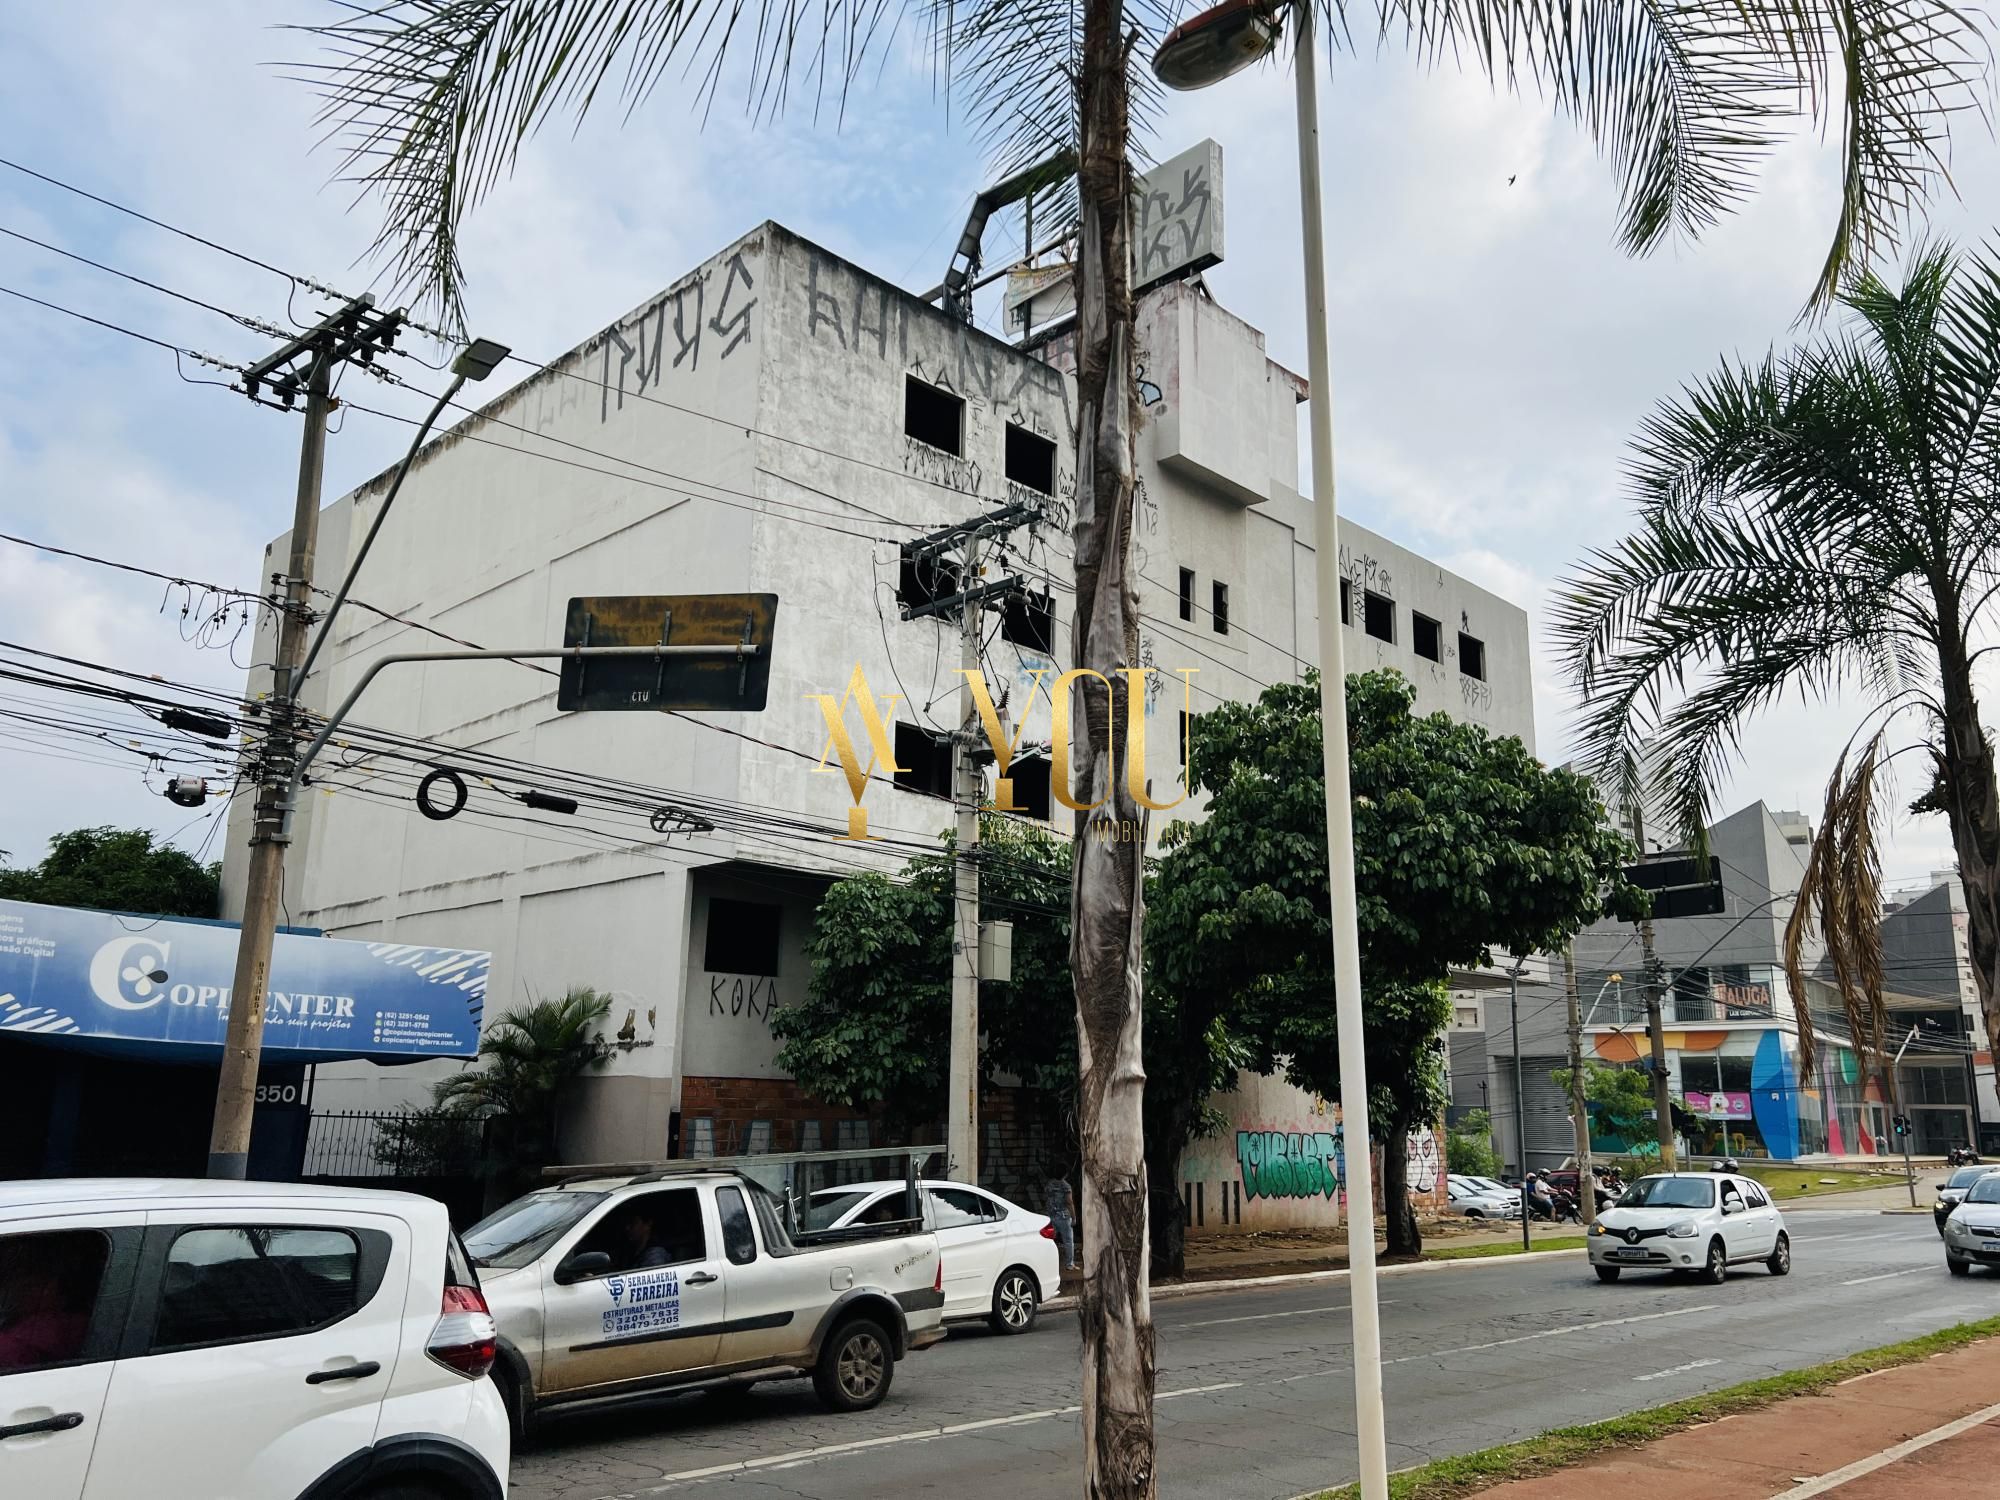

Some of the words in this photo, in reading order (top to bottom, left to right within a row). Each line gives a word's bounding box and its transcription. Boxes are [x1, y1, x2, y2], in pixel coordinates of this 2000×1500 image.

[23, 945, 55, 958] Digital
[709, 975, 778, 1024] KOKA
[1727, 985, 1770, 1006] ALUGA
[287, 1016, 308, 1027] seus
[310, 1014, 351, 1032] projetos
[383, 1020, 396, 1028] (62)
[384, 1012, 396, 1020] (62)
[255, 1085, 296, 1103] 350
[627, 1270, 678, 1288] SERRALHERIA
[629, 1281, 679, 1303] FERREIRA
[602, 1305, 644, 1319] ESTRUTURAS
[616, 1308, 680, 1325] 3206-7832
[616, 1315, 680, 1332] 98479-2205
